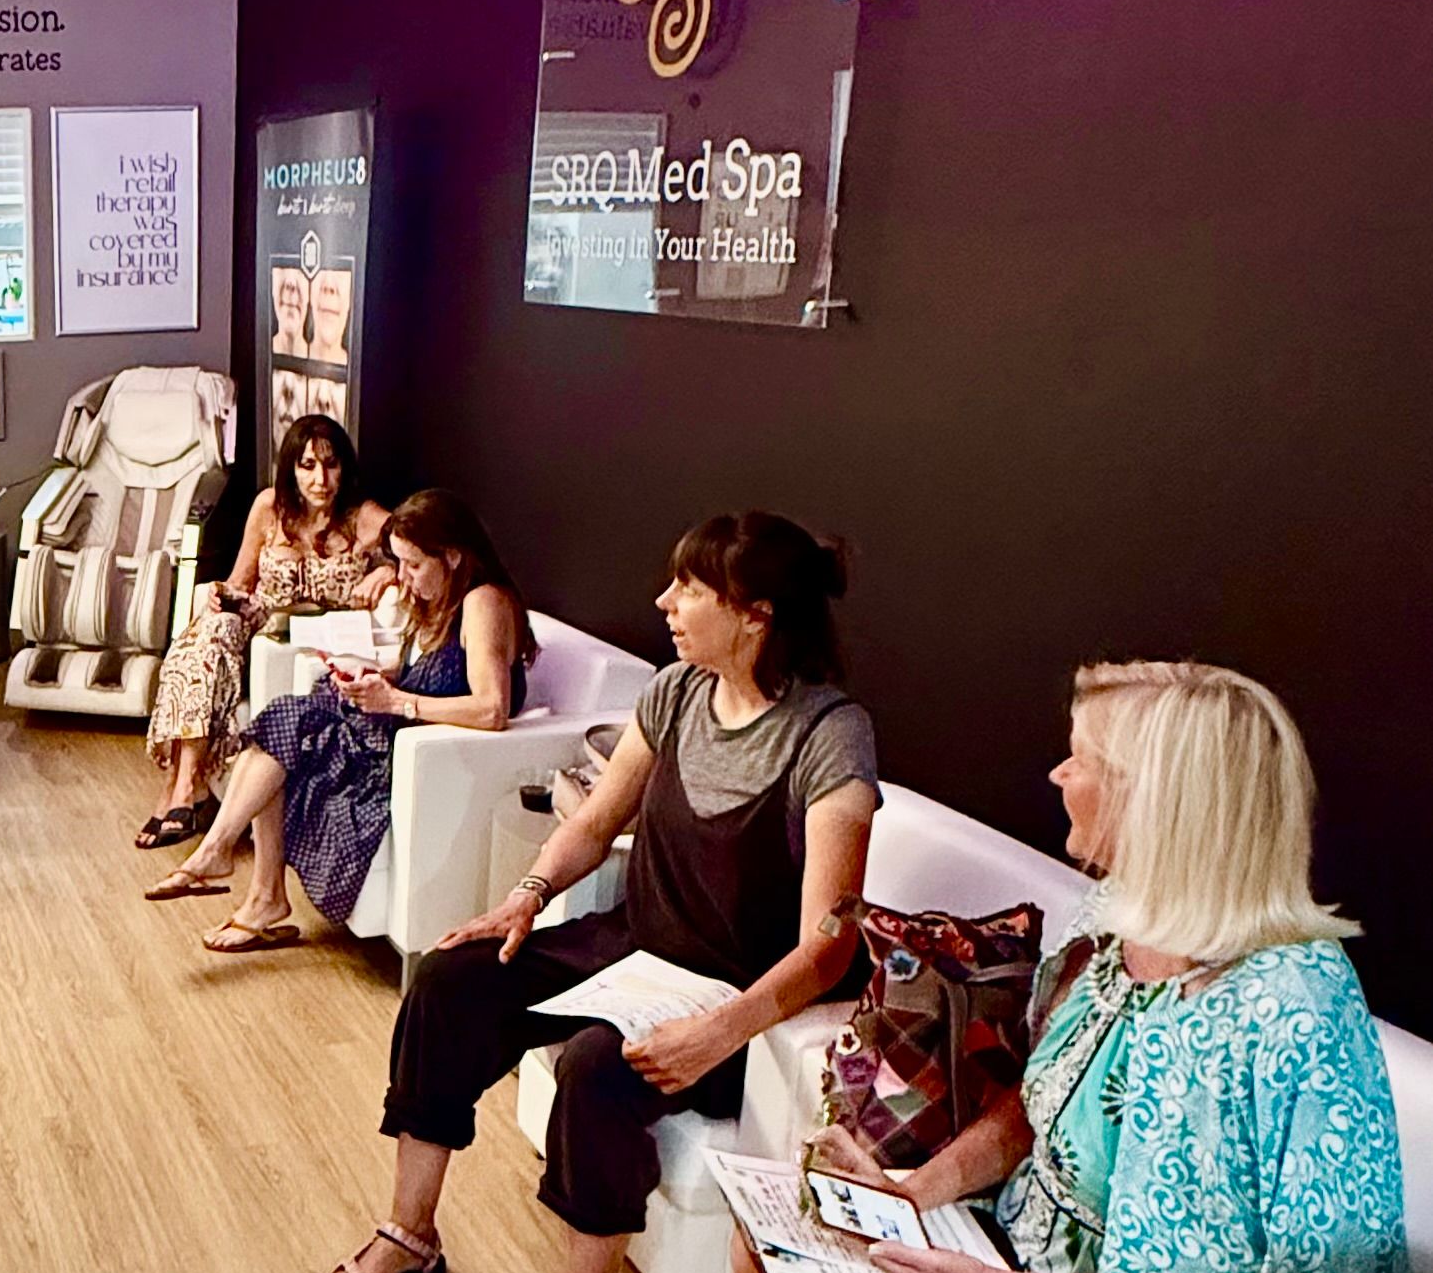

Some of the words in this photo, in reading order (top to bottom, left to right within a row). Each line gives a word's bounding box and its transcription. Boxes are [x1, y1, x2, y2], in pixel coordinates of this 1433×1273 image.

[130, 152, 178, 174] wish
[264, 155, 366, 190] MORPHEUS8
[125, 173, 176, 194] retail
[551, 150, 618, 214] SRQ
[626, 140, 712, 204] Med
[721, 137, 802, 217] Spa
[96, 191, 176, 217] therapy
[133, 215, 177, 231] was
[89, 231, 177, 251] covered
[629, 232, 649, 260] in
[654, 226, 706, 262] Your
[710, 227, 796, 264] Health
[118, 250, 144, 274] by
[148, 251, 178, 274] my
[76, 268, 178, 288] insurance
